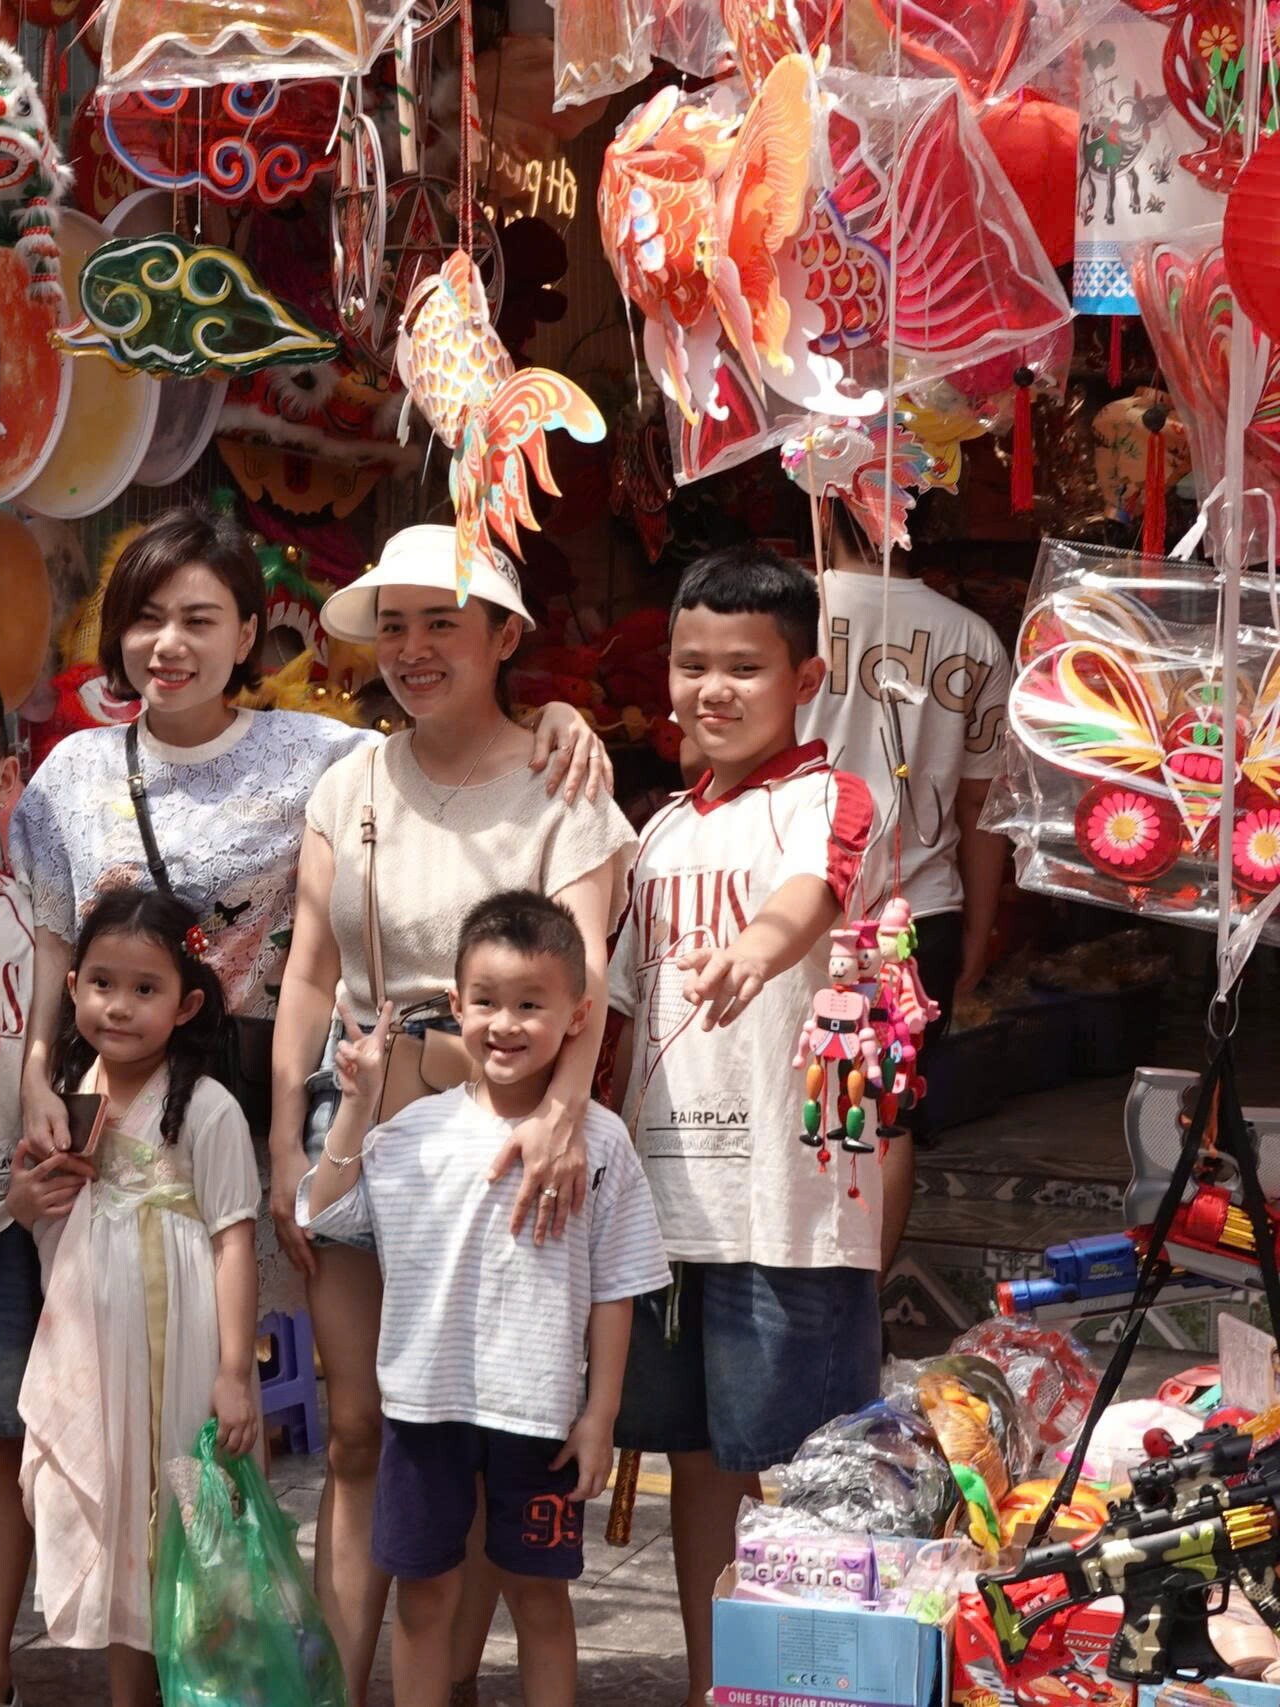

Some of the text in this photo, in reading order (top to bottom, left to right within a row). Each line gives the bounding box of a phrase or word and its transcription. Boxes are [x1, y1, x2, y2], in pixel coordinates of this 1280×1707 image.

[670, 1111, 749, 1124] FAIRPLAY
[728, 1690, 753, 1706] ONE
[754, 1693, 776, 1707] SET
